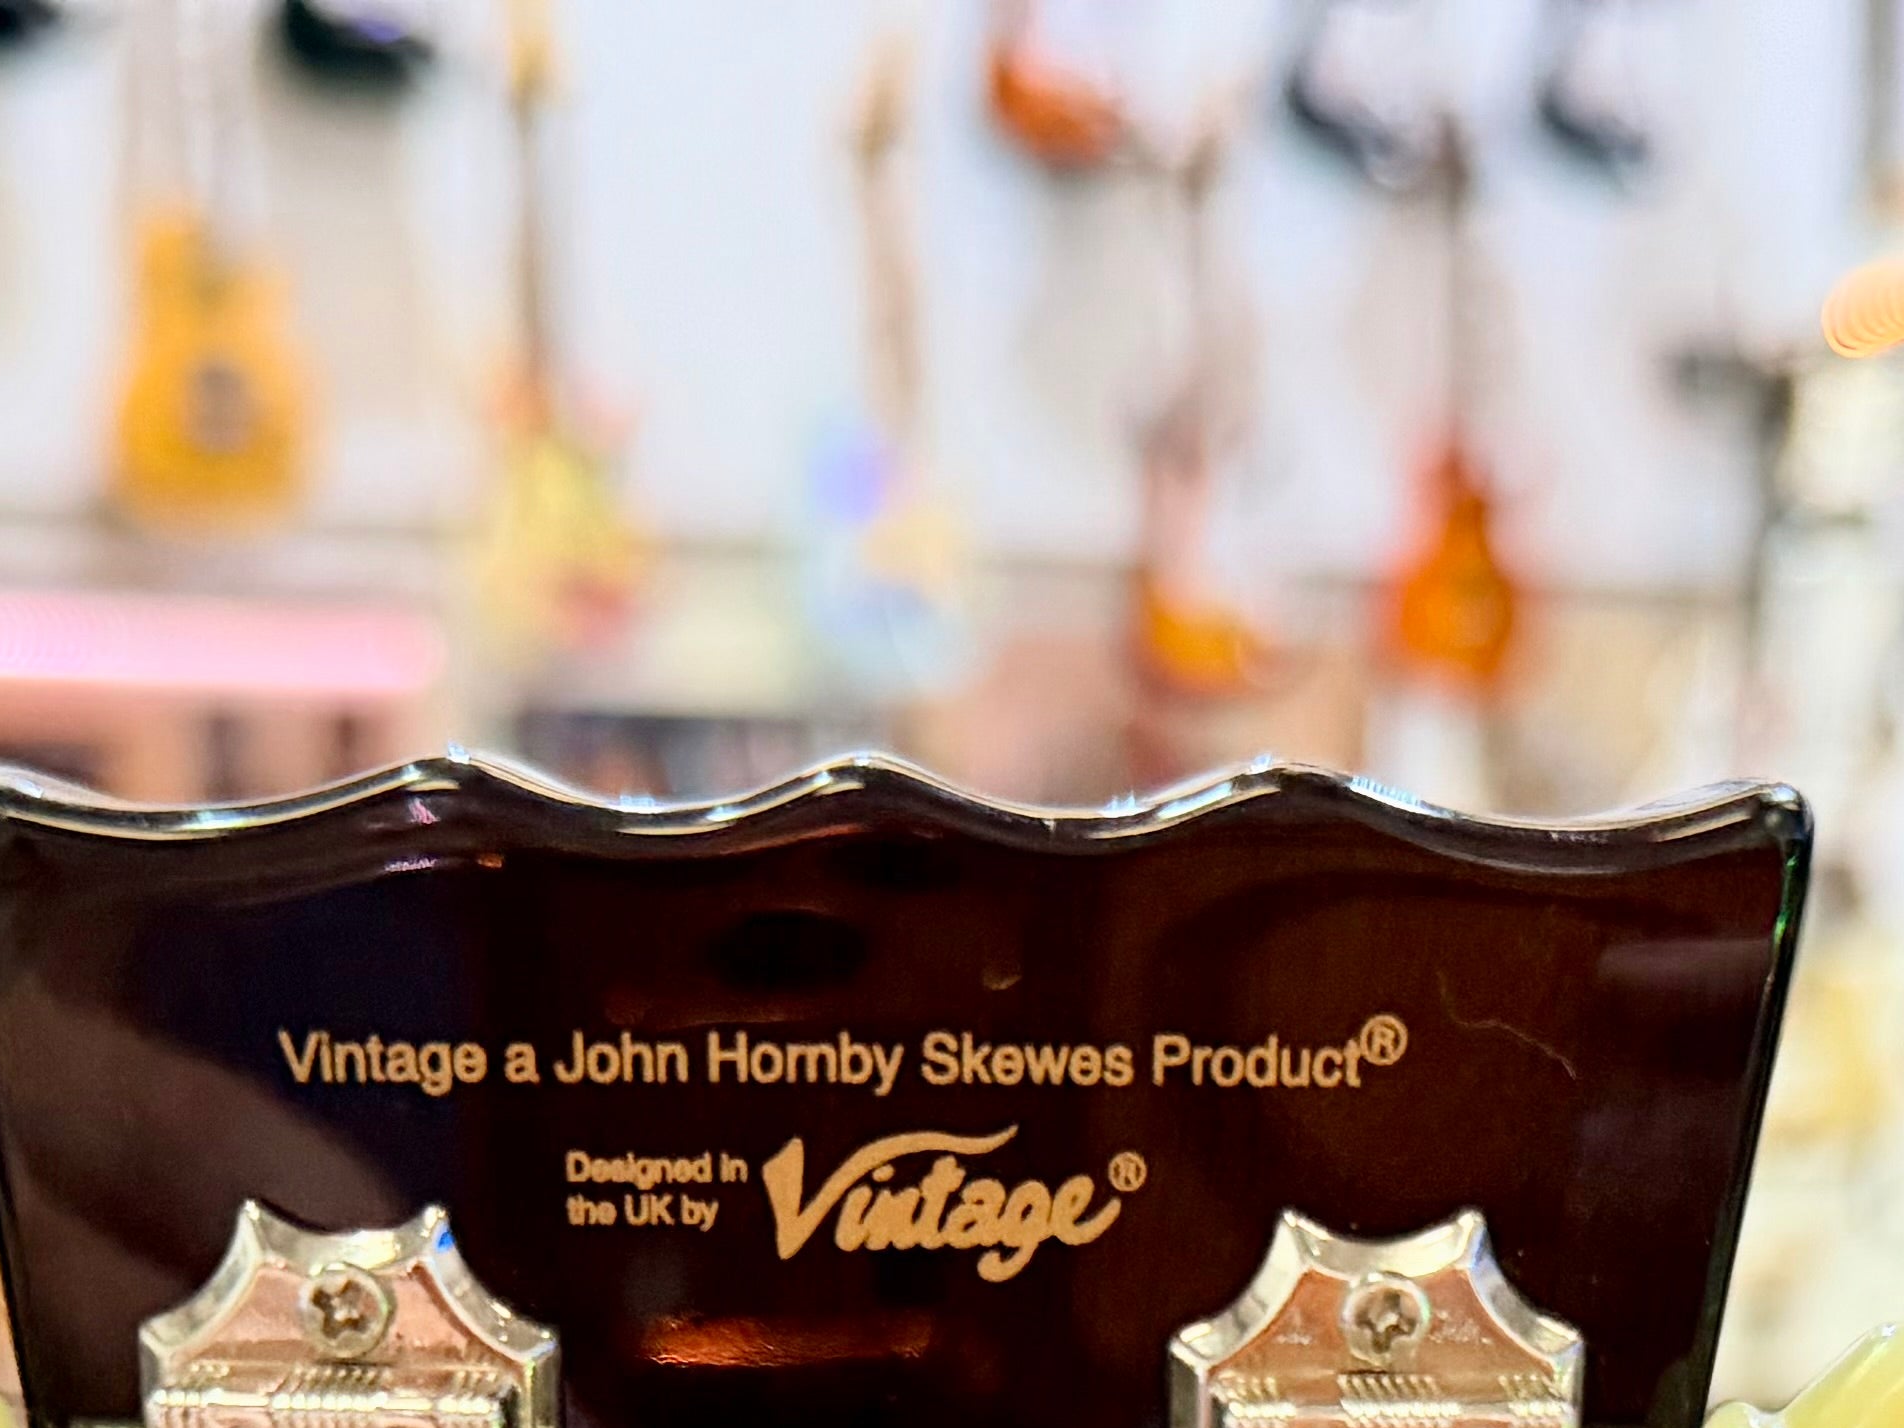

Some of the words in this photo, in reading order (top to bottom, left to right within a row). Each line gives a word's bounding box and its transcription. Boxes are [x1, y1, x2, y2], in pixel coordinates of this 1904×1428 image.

[279, 1032, 487, 1096] Vintage
[505, 1043, 539, 1083] a
[555, 1032, 688, 1083] John
[708, 1032, 904, 1097] Hornby
[921, 1032, 1134, 1086] Skewes
[565, 1151, 712, 1190] Designed
[719, 1152, 748, 1183] in
[567, 1195, 616, 1226] the
[624, 1194, 673, 1225] UK
[681, 1194, 719, 1231] by
